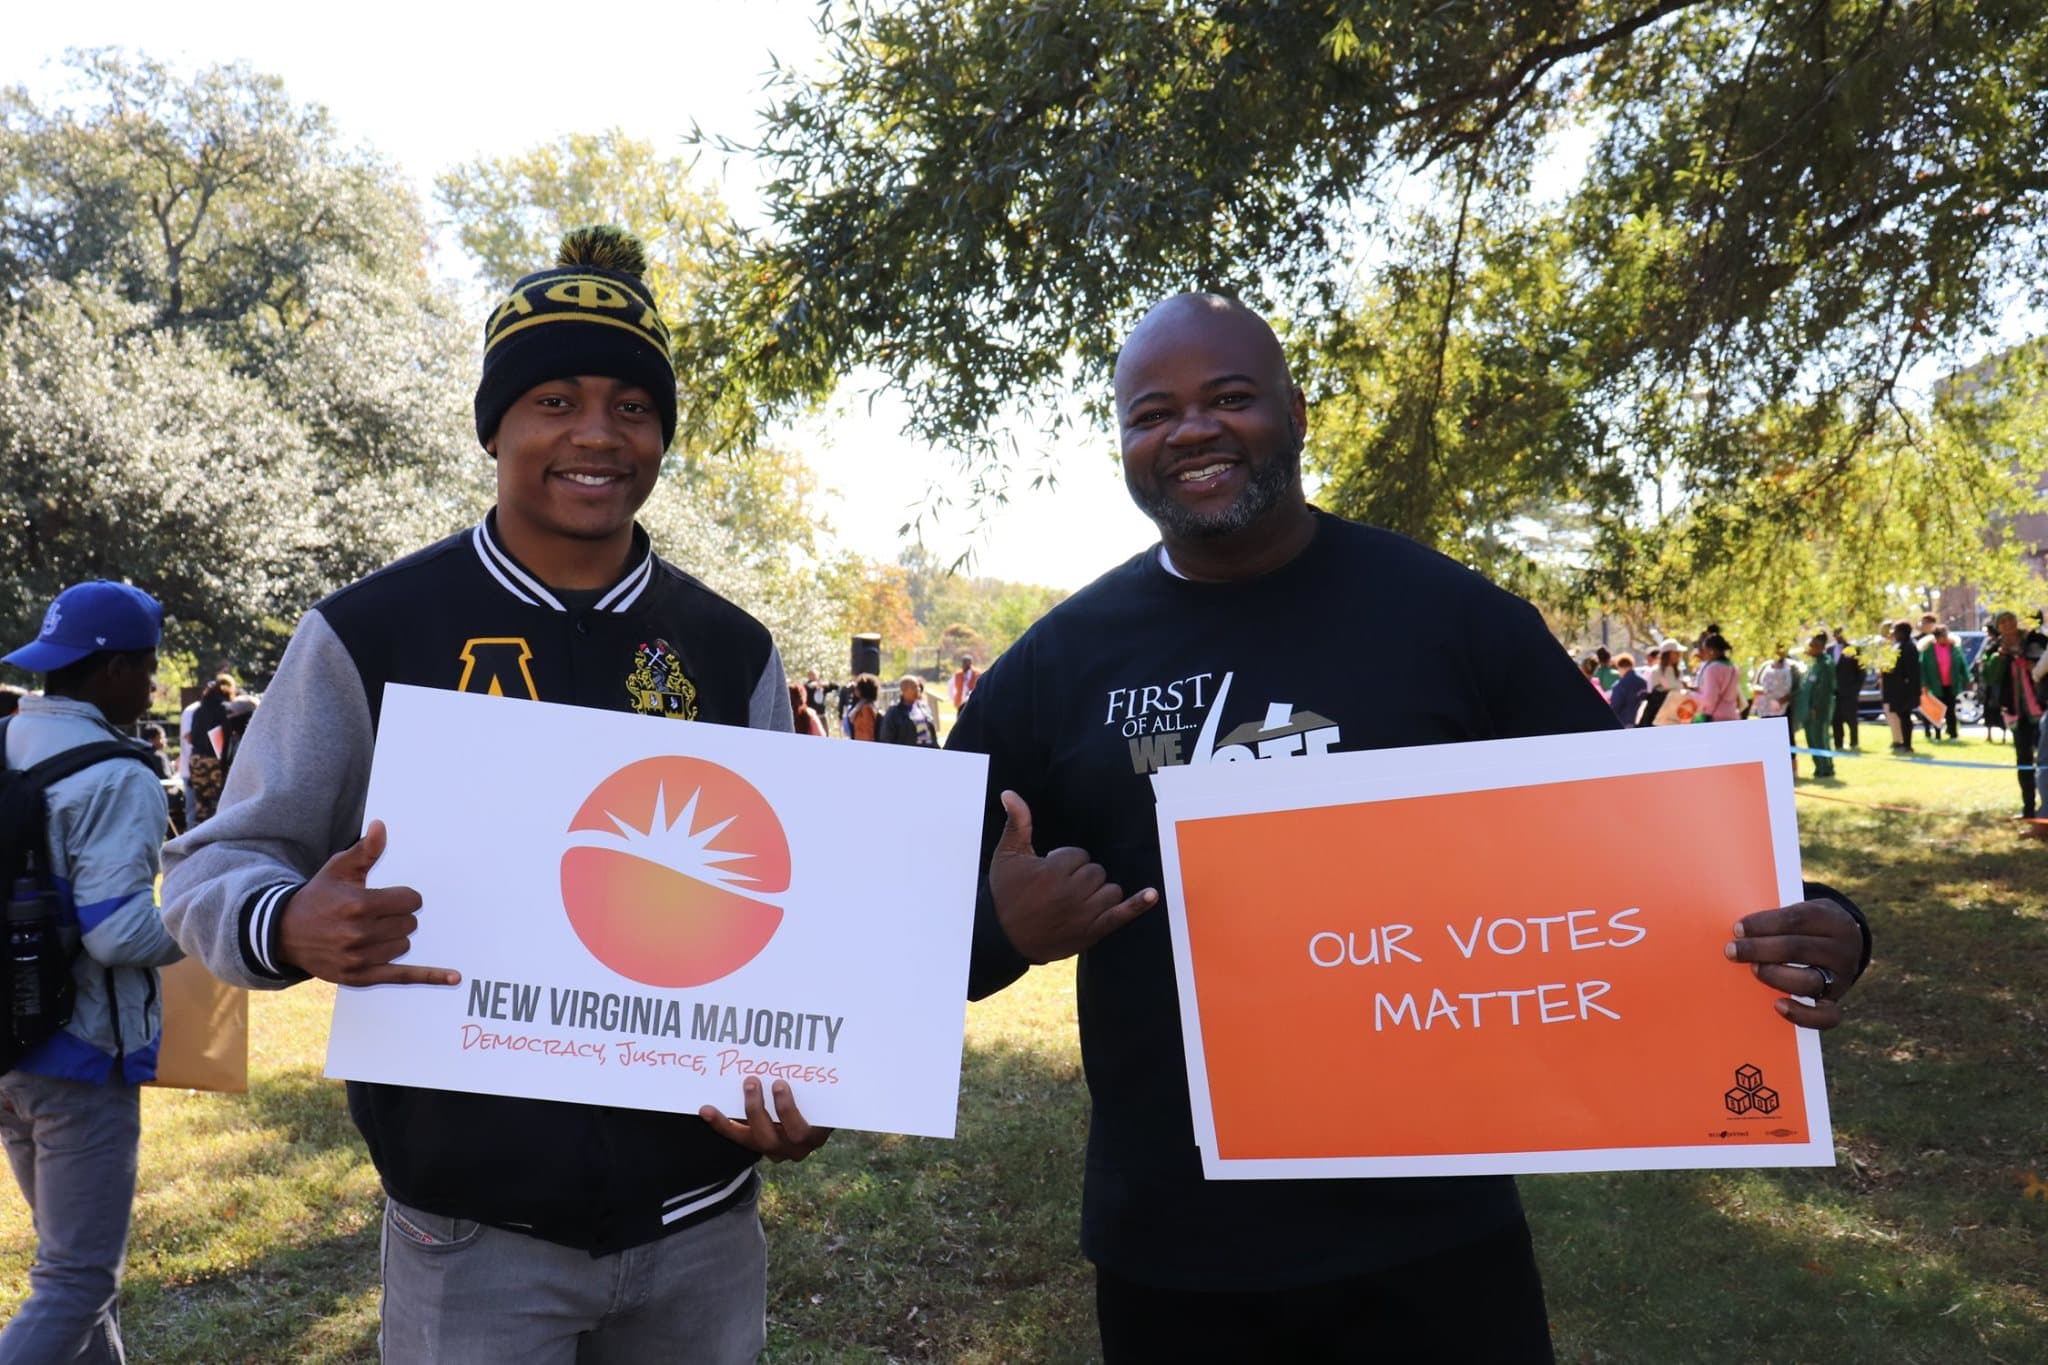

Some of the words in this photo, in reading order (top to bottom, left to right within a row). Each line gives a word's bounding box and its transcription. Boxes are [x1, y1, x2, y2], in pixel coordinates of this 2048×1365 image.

[1104, 673, 1212, 725] FIRST
[1122, 717, 1147, 738] OF
[1151, 714, 1198, 733] ALL...
[1128, 733, 1185, 775] WE
[1309, 924, 1423, 967] OUR
[1446, 908, 1646, 959] VOTES
[467, 979, 541, 1023] NEW
[550, 987, 681, 1038] VIRGINIA
[691, 1003, 844, 1054] MAJORITY
[1375, 980, 1621, 1031] MATTER
[461, 1024, 606, 1065] DEMOCRACY,
[616, 1041, 707, 1075] JUSTICE,
[717, 1049, 839, 1084] PROGRESS
